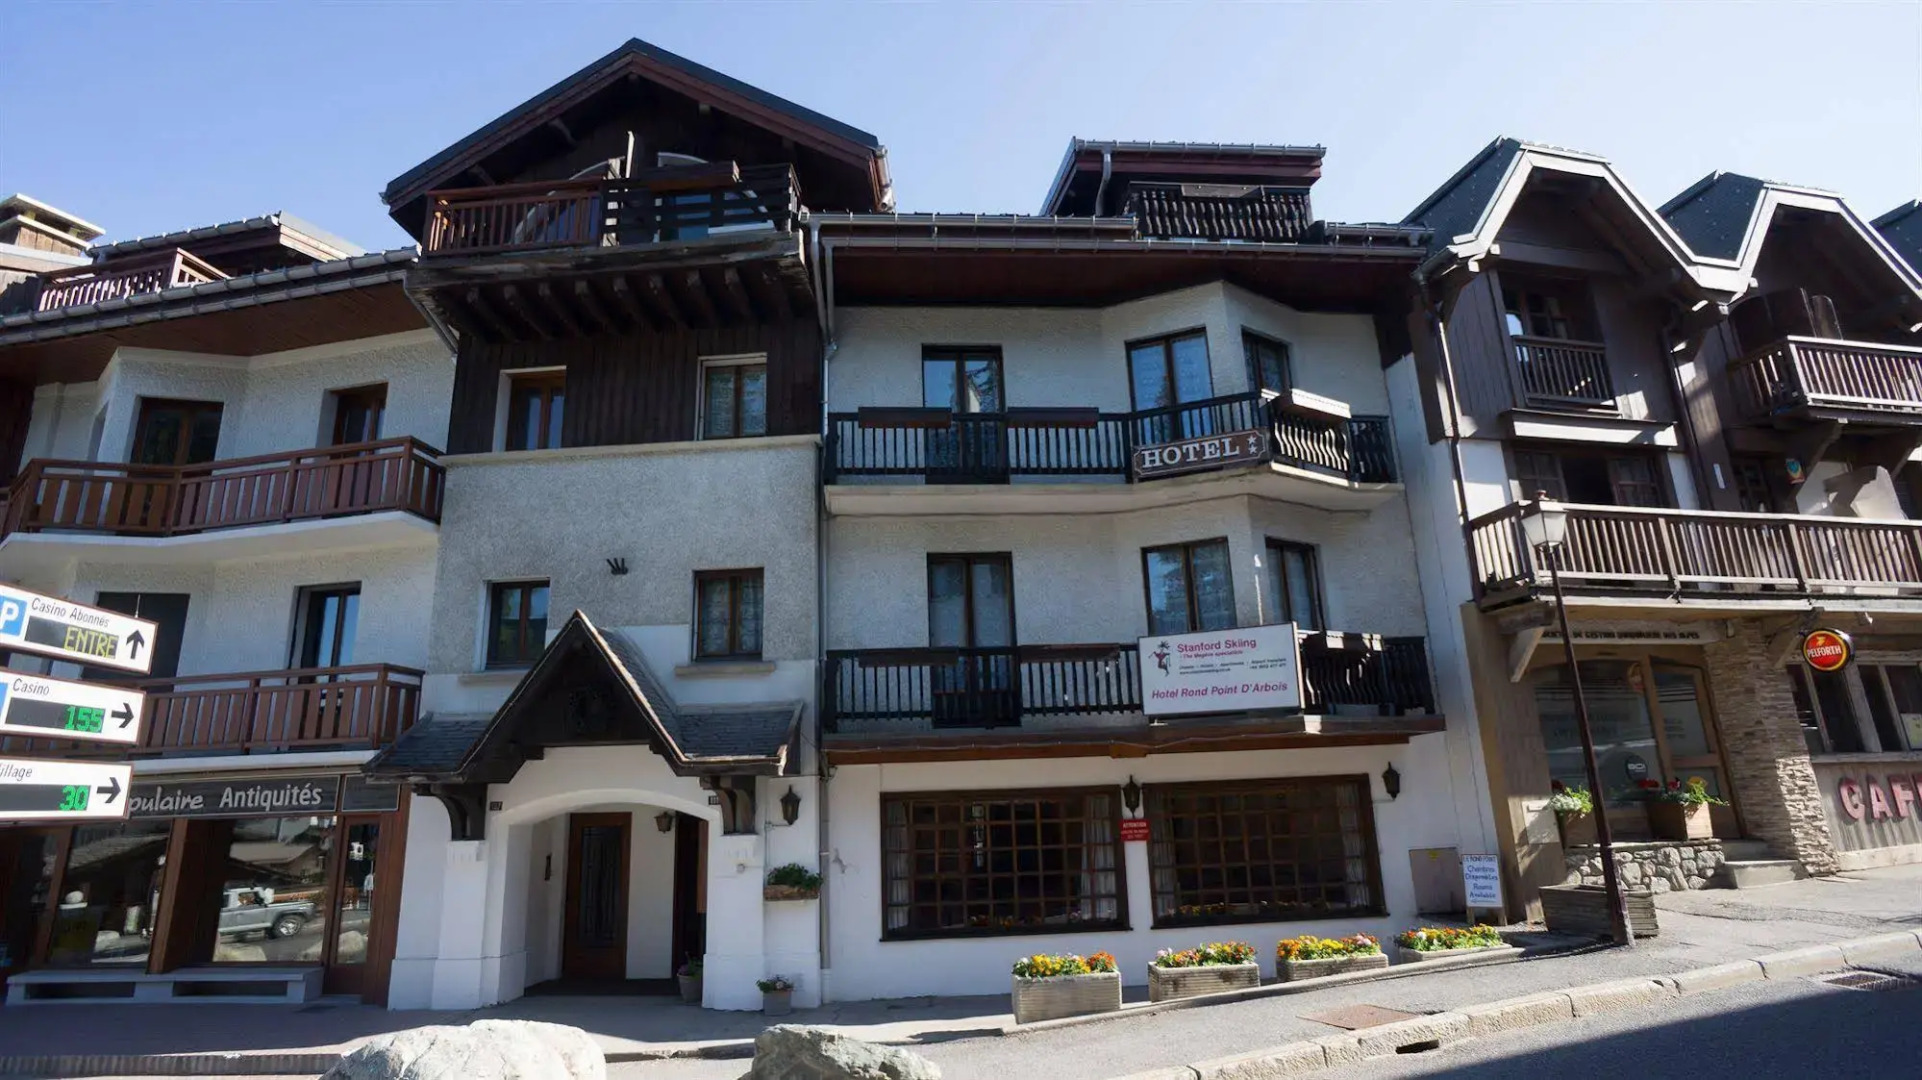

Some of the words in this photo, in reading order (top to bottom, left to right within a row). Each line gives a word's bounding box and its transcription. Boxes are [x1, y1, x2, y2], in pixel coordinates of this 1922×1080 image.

[1141, 438, 1239, 468] HOTEL
[32, 597, 66, 617] Casino
[64, 625, 118, 658] ENTRE
[1177, 641, 1221, 653] Stanford
[1224, 639, 1256, 649] Skiing
[1807, 645, 1842, 658] PELFORTH
[13, 678, 50, 696] Casino
[1152, 689, 1179, 699] Hotel
[1181, 685, 1208, 697] Rond
[1211, 683, 1237, 695] Point
[1241, 681, 1288, 693] D'Arbois
[65, 705, 105, 733] 155
[0, 763, 33, 781] illage
[60, 785, 90, 811] 30
[219, 783, 322, 811] Antiquités
